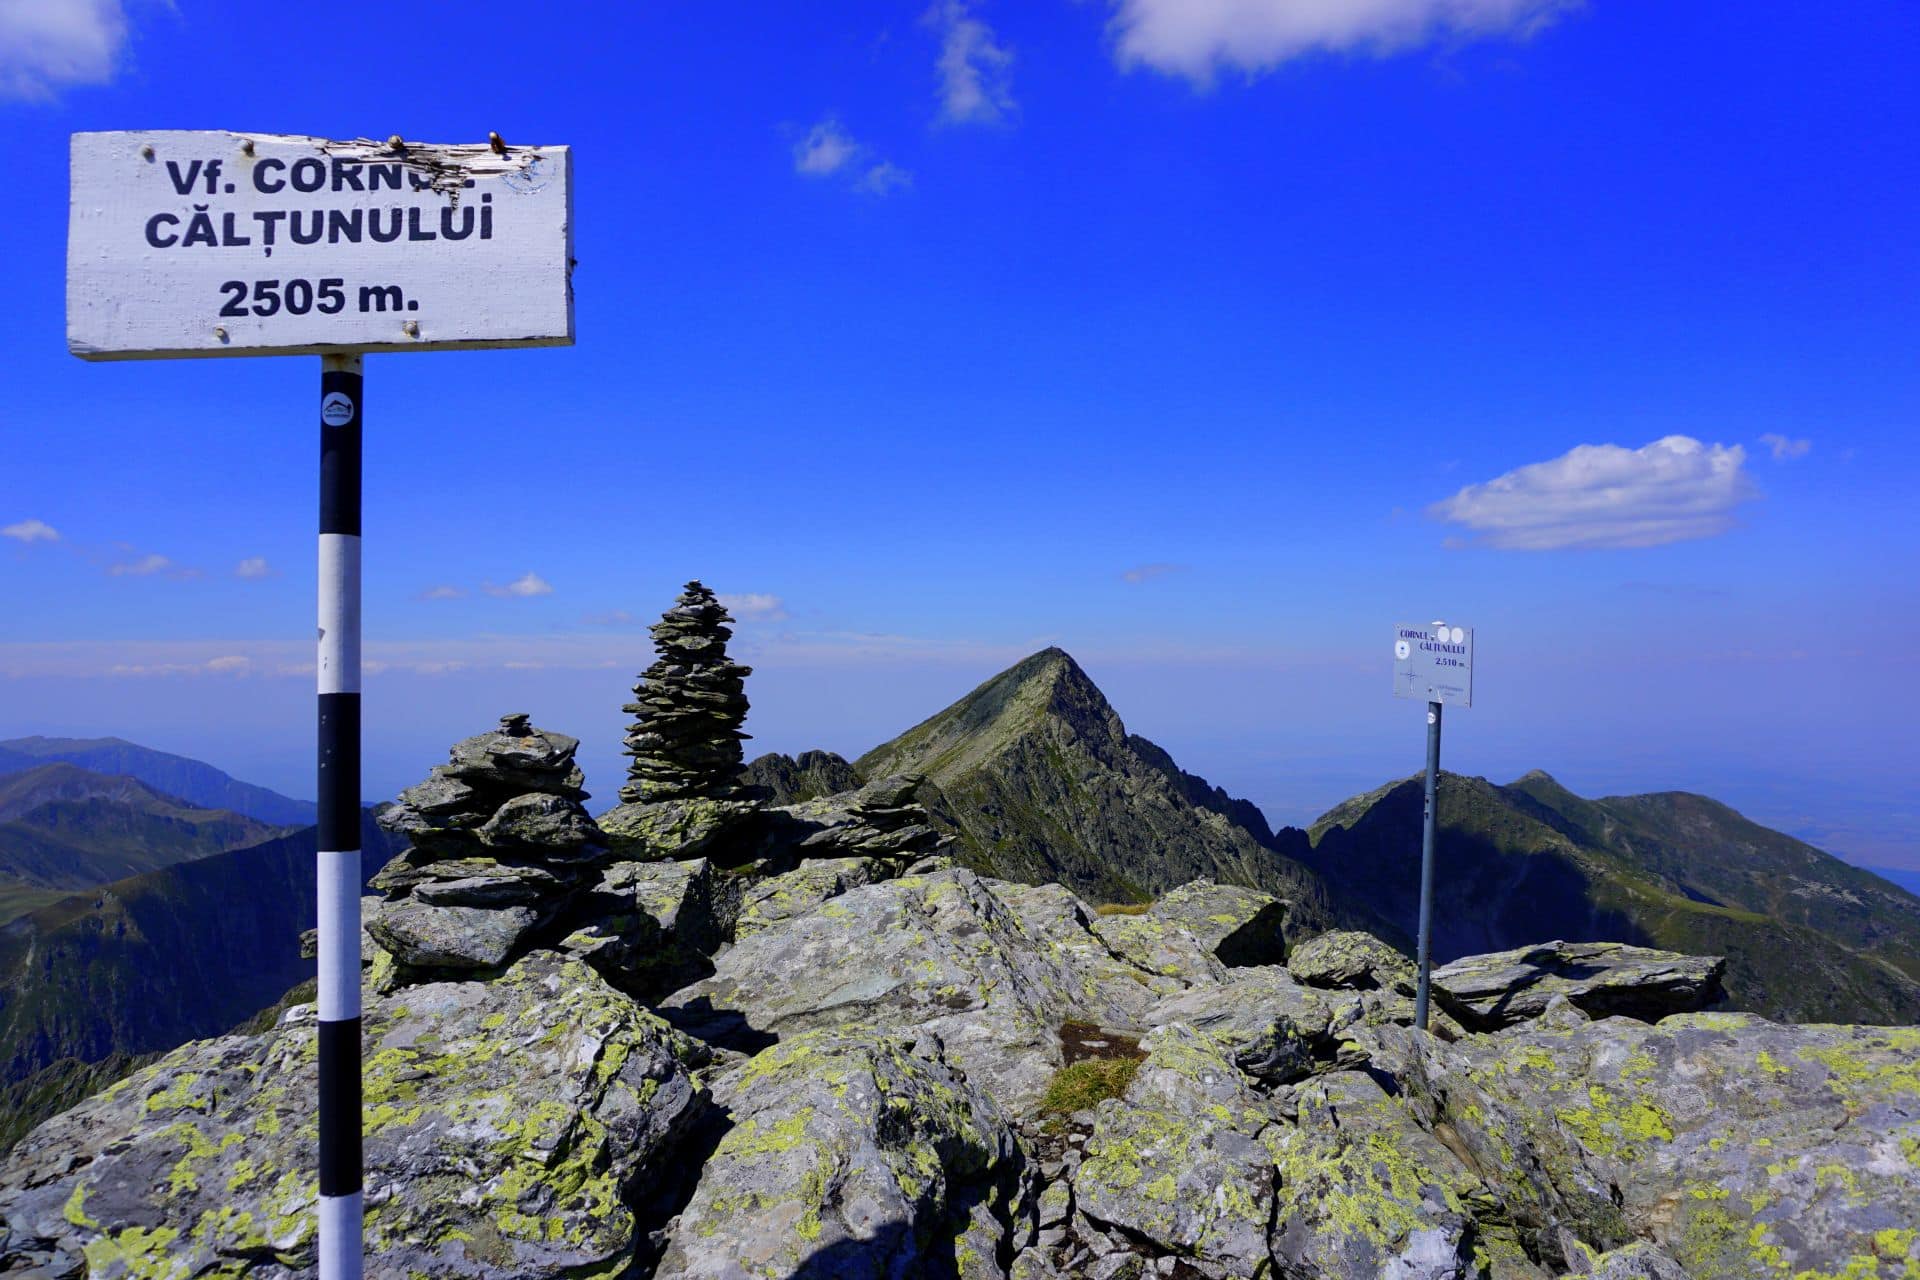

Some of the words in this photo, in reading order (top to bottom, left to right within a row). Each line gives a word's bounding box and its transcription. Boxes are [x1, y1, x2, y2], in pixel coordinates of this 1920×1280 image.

[165, 160, 235, 196] Vf.
[219, 278, 345, 317] 2505
[358, 283, 420, 313] m.
[1435, 657, 1457, 667] 2.510
